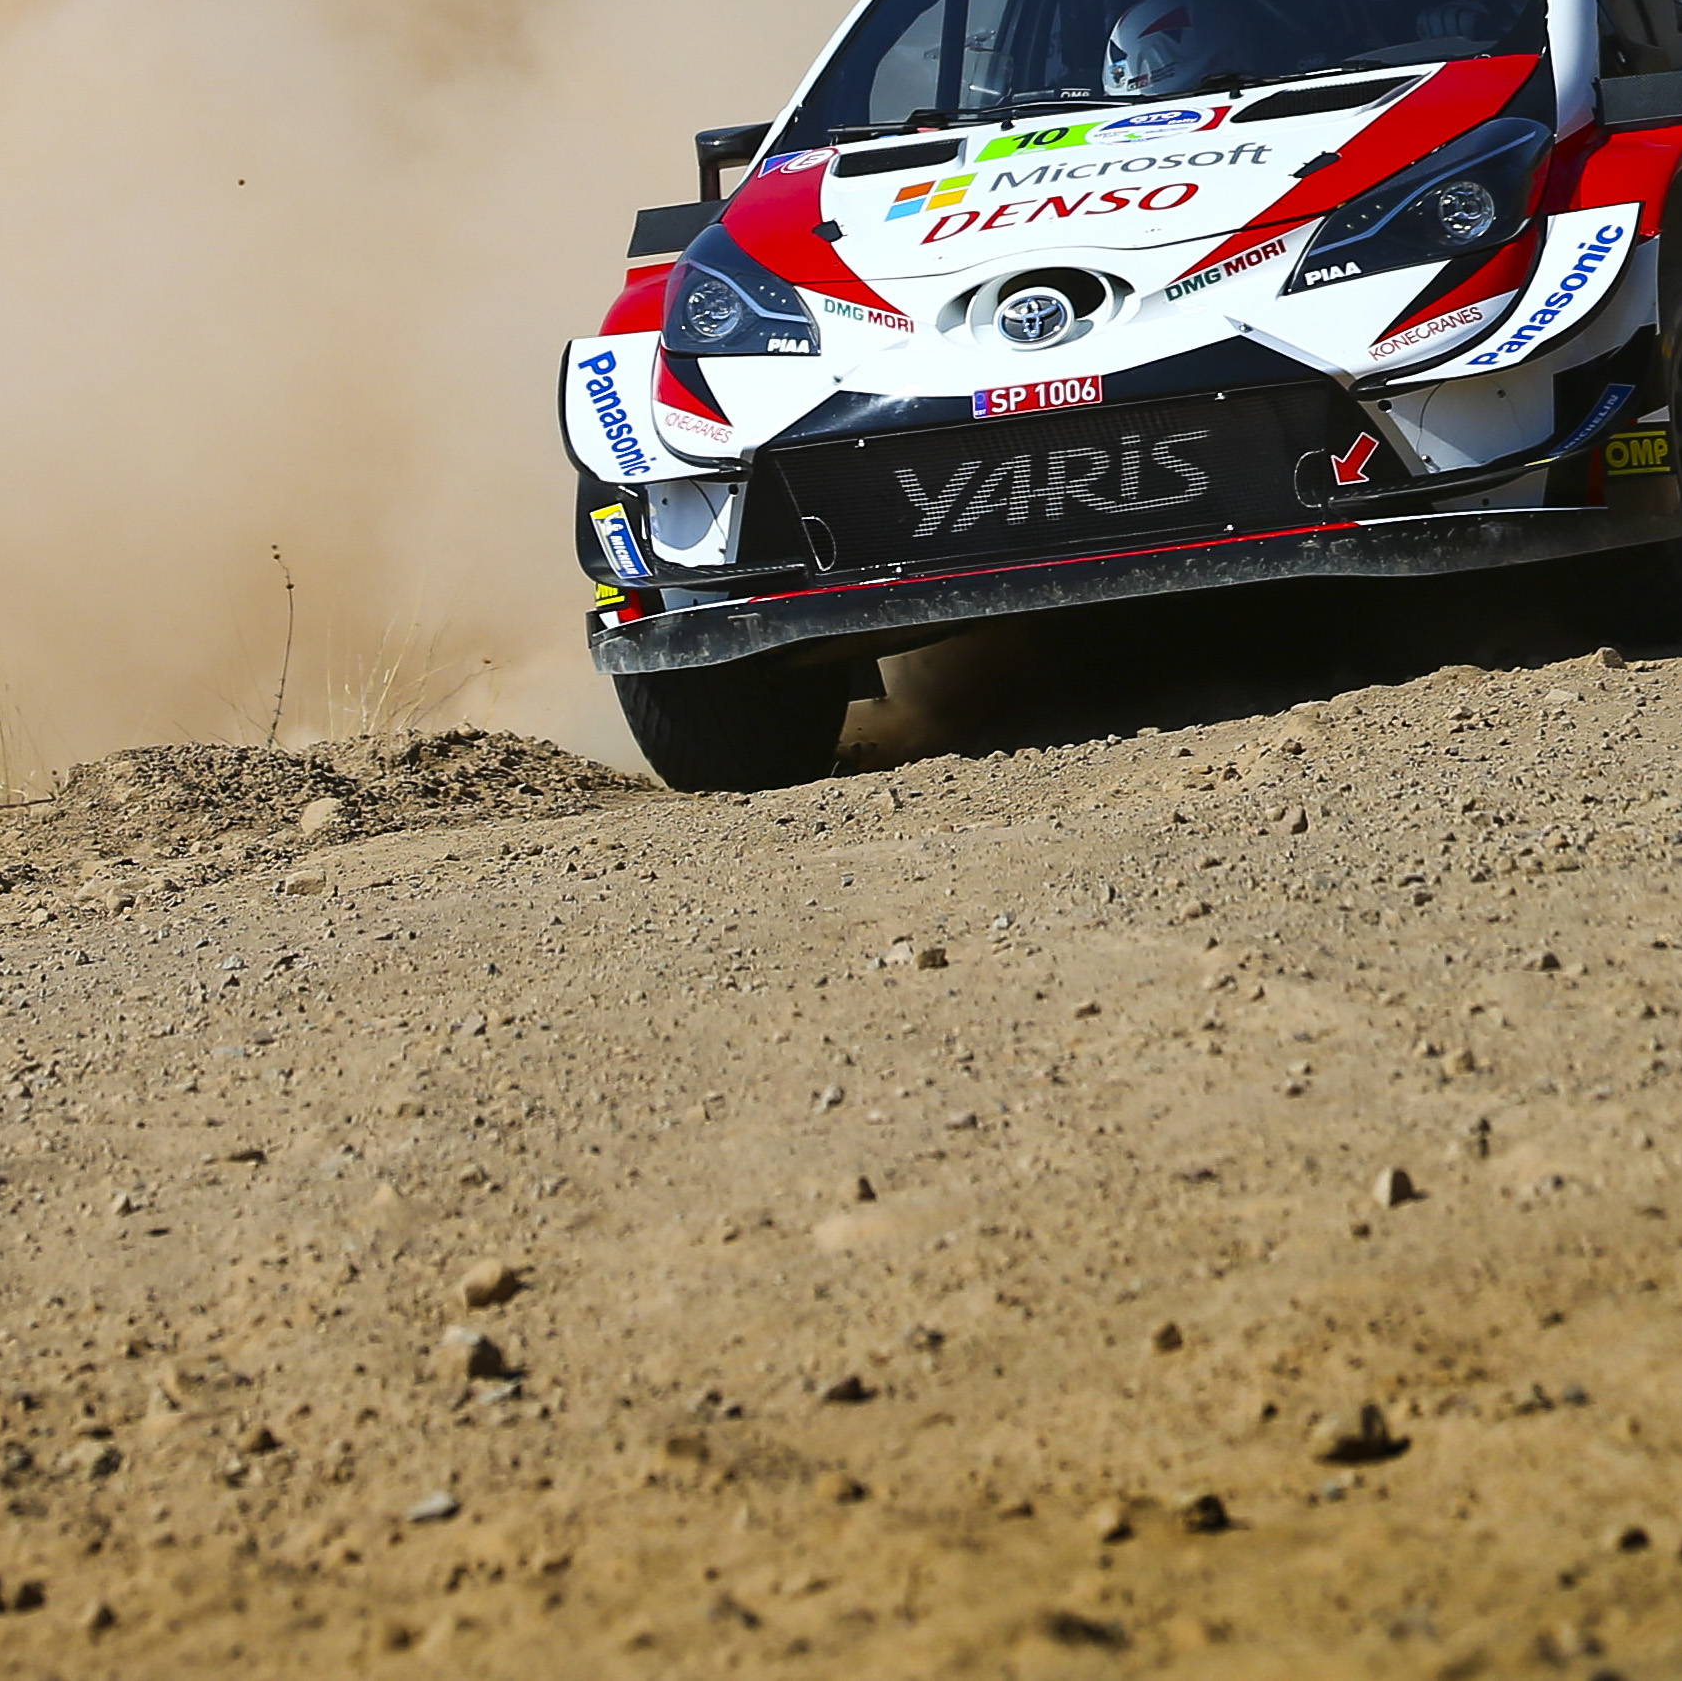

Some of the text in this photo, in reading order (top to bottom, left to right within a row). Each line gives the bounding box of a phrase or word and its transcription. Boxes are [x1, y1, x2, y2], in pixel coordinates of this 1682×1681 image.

[1012, 127, 1070, 150] 10
[988, 141, 1273, 193] Microsoft
[919, 182, 1200, 245] DENSO
[1164, 238, 1287, 303] DMG MORI
[1305, 261, 1362, 286] PIAA
[823, 297, 915, 334] DMG MORI
[1466, 223, 1625, 366] Panasonic
[767, 338, 811, 354] PIAA
[1368, 306, 1484, 361] KONECRANES
[578, 350, 659, 478] Panasonic
[990, 377, 1097, 414] SP 1006
[663, 411, 733, 445] KONECRANES
[1563, 394, 1619, 449] MICHELIN
[1605, 437, 1669, 468] OMP
[608, 534, 640, 576] MICHELIN
